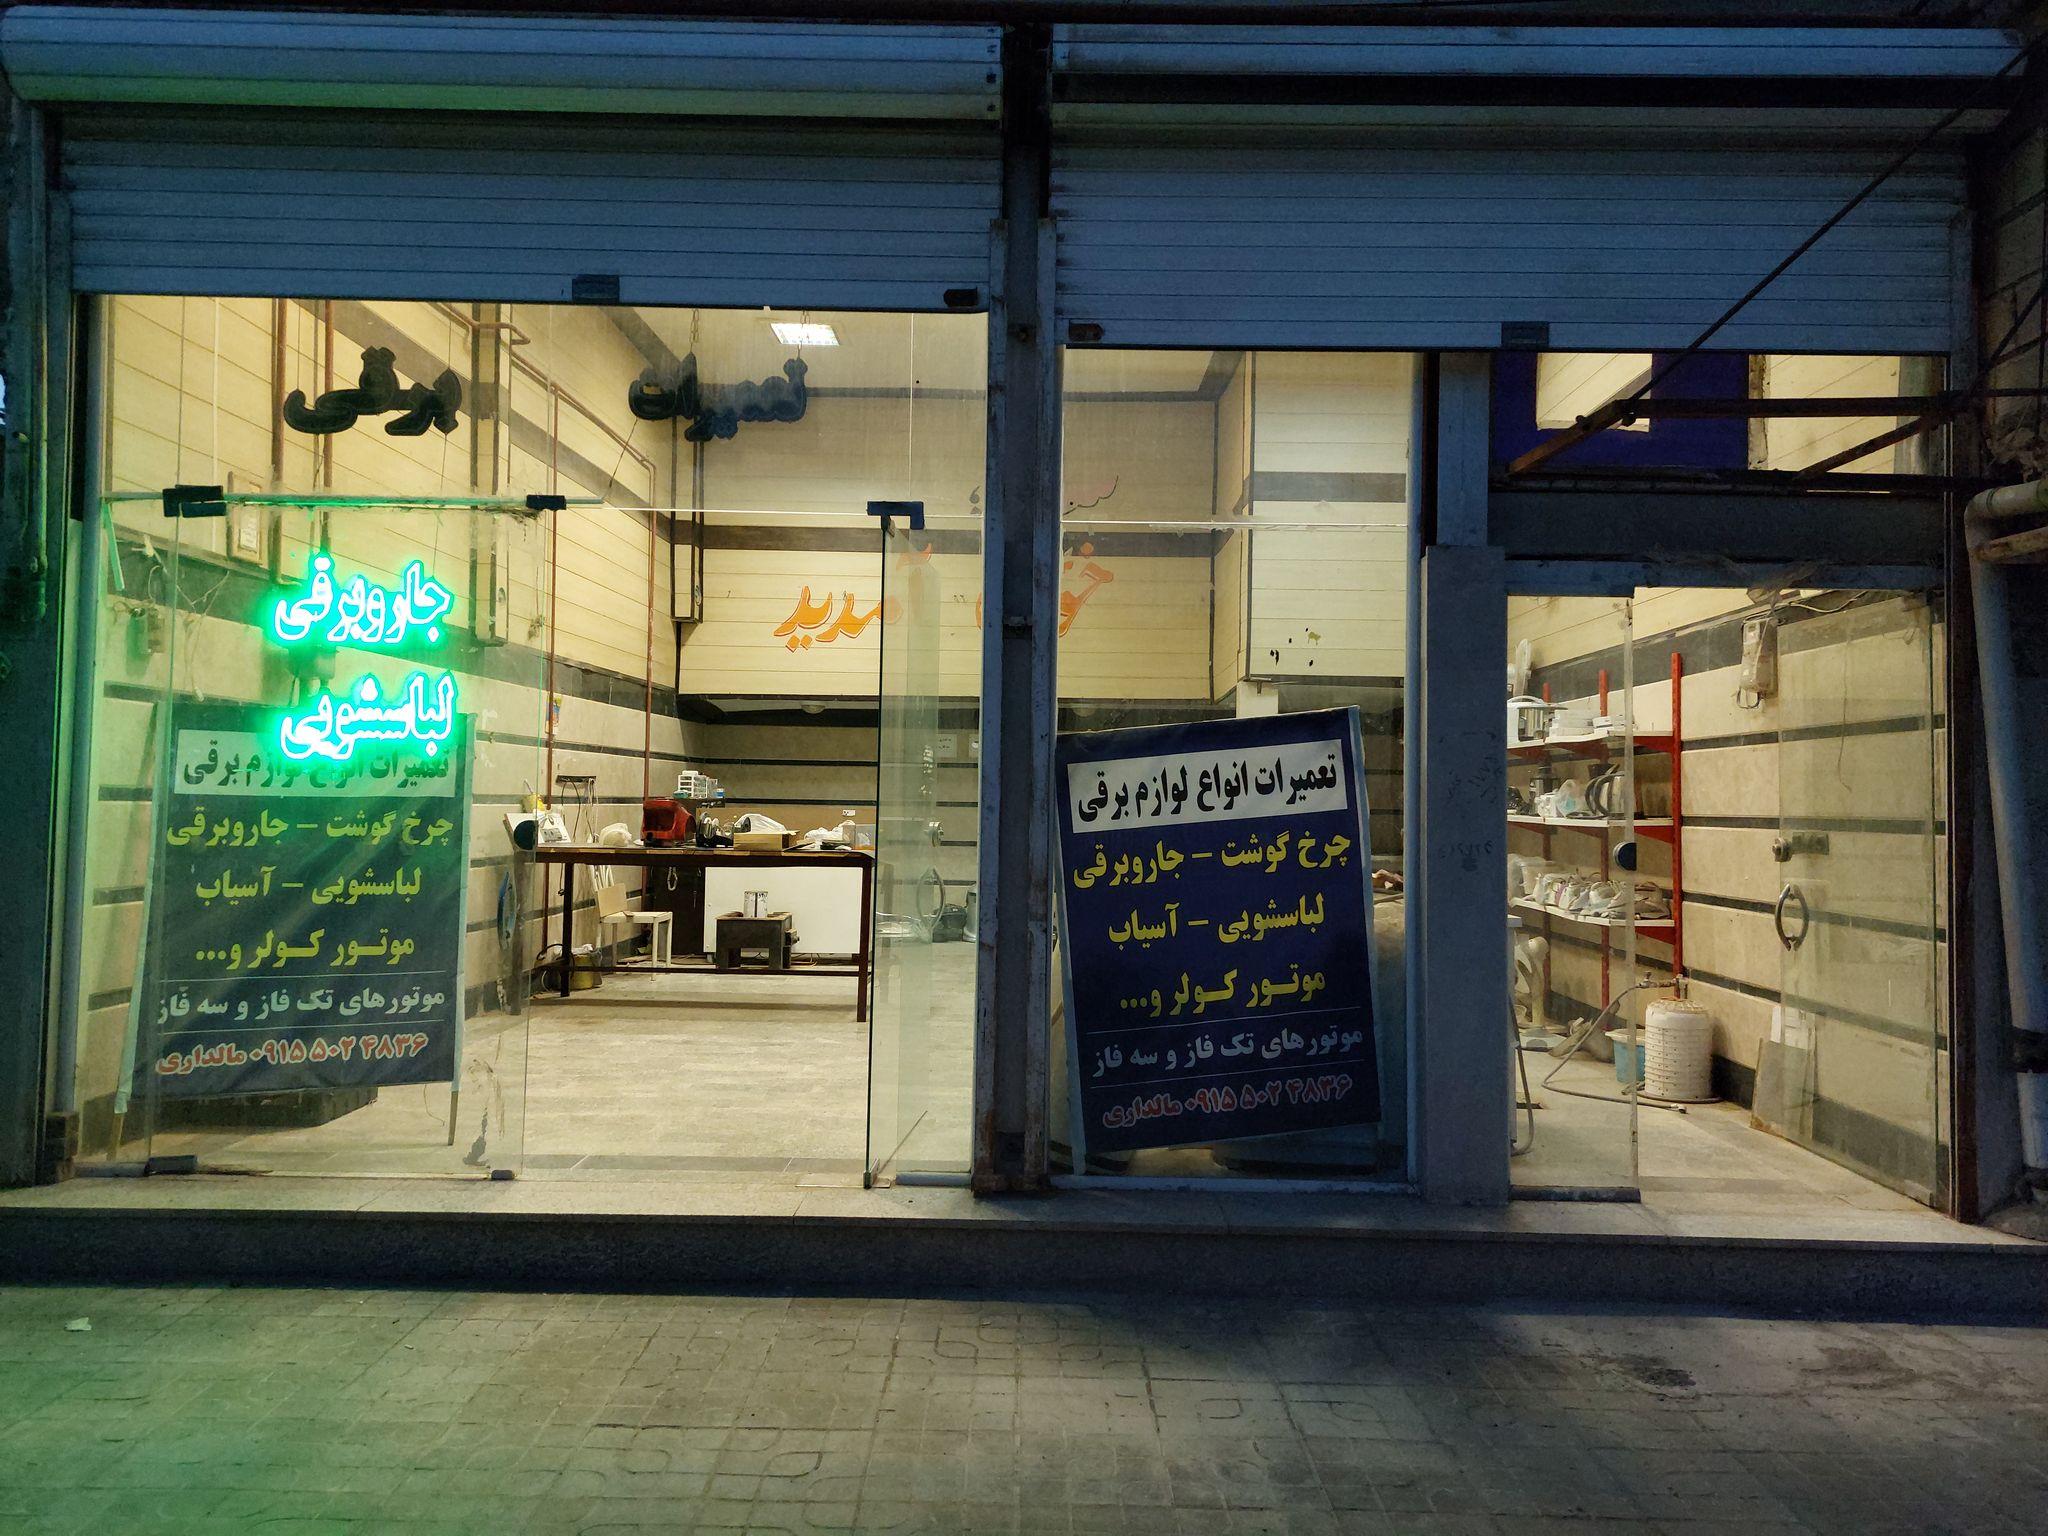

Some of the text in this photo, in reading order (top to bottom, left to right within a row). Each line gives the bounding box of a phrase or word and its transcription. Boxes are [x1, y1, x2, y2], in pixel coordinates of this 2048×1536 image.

[274, 556, 452, 644] جاروبرقی
[280, 674, 455, 761] لباسشویی
[183, 739, 240, 786] برقی
[1078, 753, 1337, 823] تعمیرات انواع لوازم برقی
[166, 806, 289, 847] جاروبرقی
[326, 809, 397, 846] گوشت
[401, 810, 454, 847] چرخ
[1073, 839, 1185, 889] جاروبرقی
[1221, 830, 1290, 873] گوشت
[1298, 830, 1351, 869] چرخ
[196, 865, 277, 907] آسیاب
[311, 866, 422, 905] لباسشویی
[1108, 902, 1180, 950] آسیاب
[1218, 891, 1324, 943] لباسشویی
[157, 988, 190, 1024] فاز
[197, 998, 229, 1016] سه
[234, 1000, 248, 1021] و
[255, 988, 290, 1020] فاز
[296, 988, 333, 1011] تک
[155, 1042, 247, 1076] مالداری
[1092, 1043, 1123, 1078] فاز
[1129, 1047, 1158, 1067] سه
[1165, 1048, 1177, 1070] و
[1184, 1033, 1214, 1068] فاز
[1220, 1032, 1255, 1055] تک
[1102, 1092, 1184, 1129] مالداری
